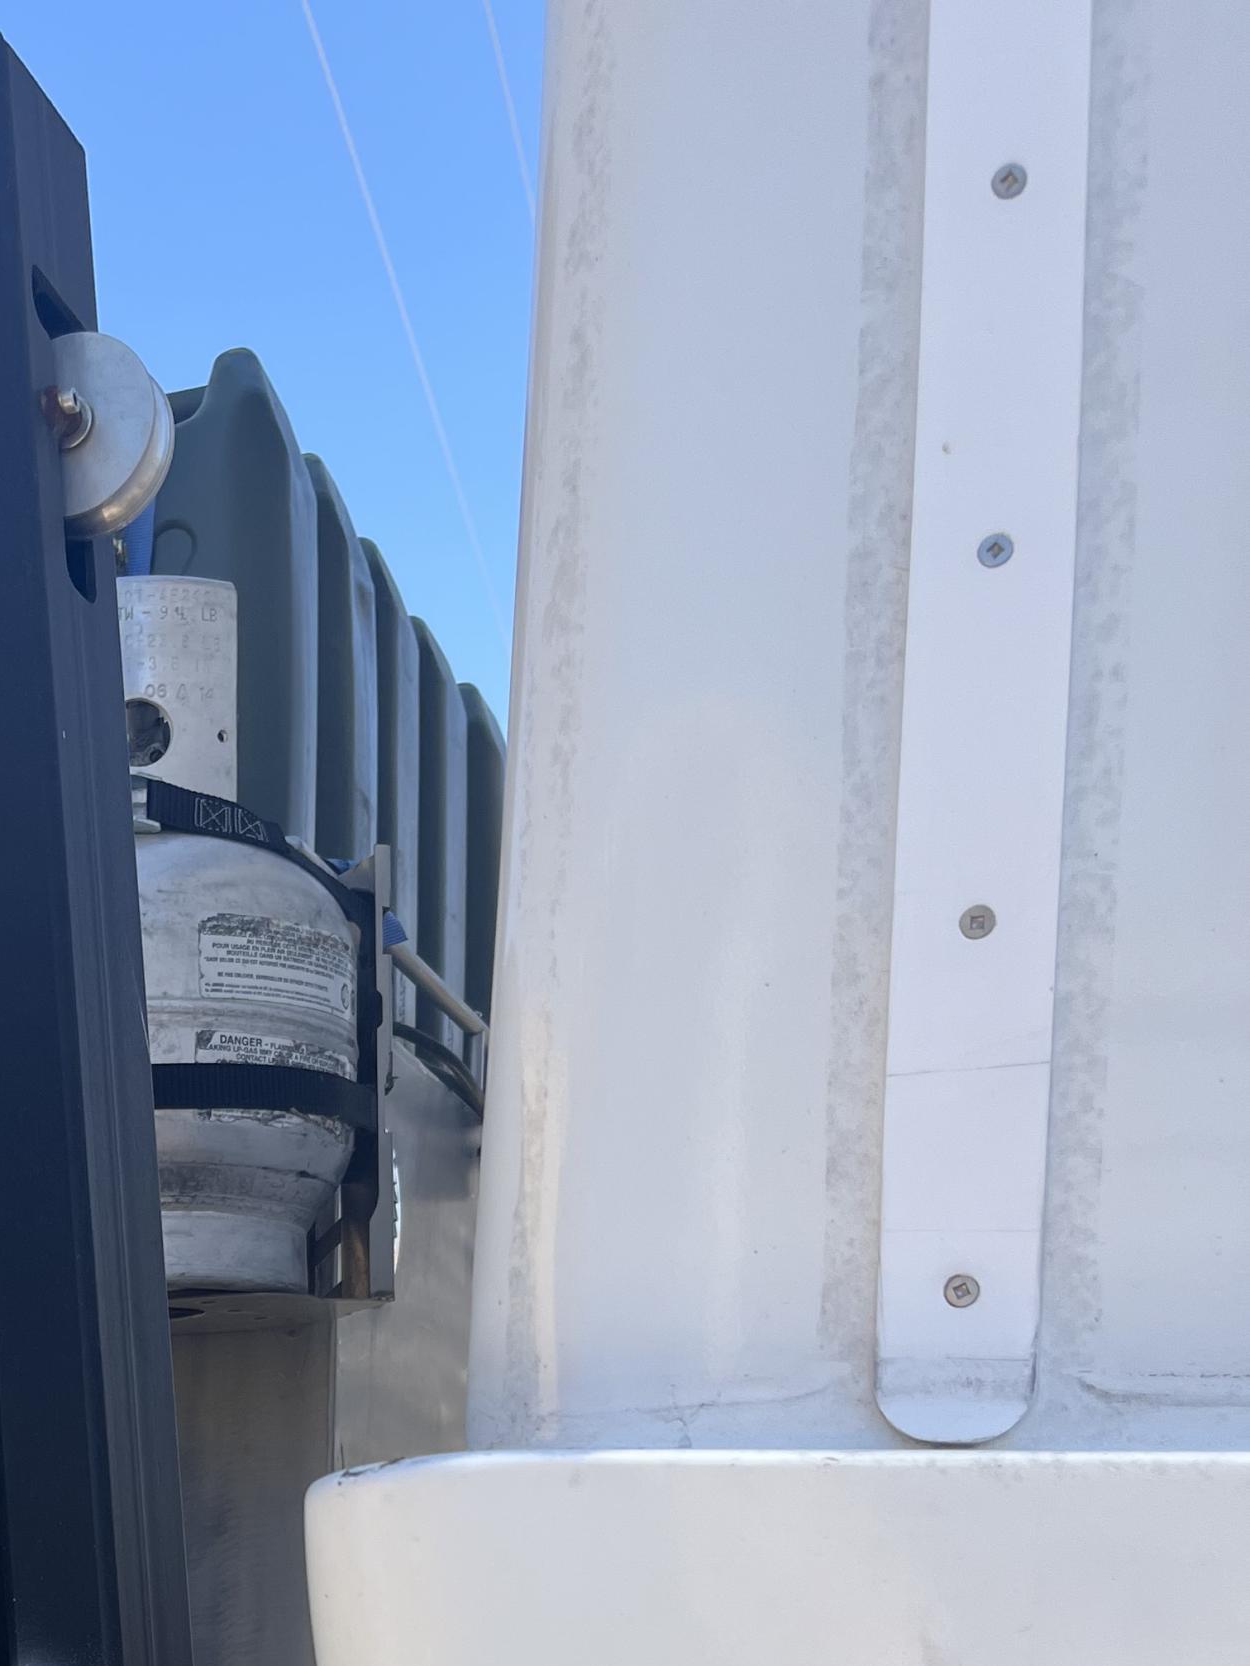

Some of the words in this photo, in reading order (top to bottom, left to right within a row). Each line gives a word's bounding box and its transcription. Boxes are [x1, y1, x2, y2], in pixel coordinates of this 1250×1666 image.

[201, 607, 218, 622] LB
[220, 1034, 262, 1047] DANGER
[236, 1053, 266, 1062] CONTACT
